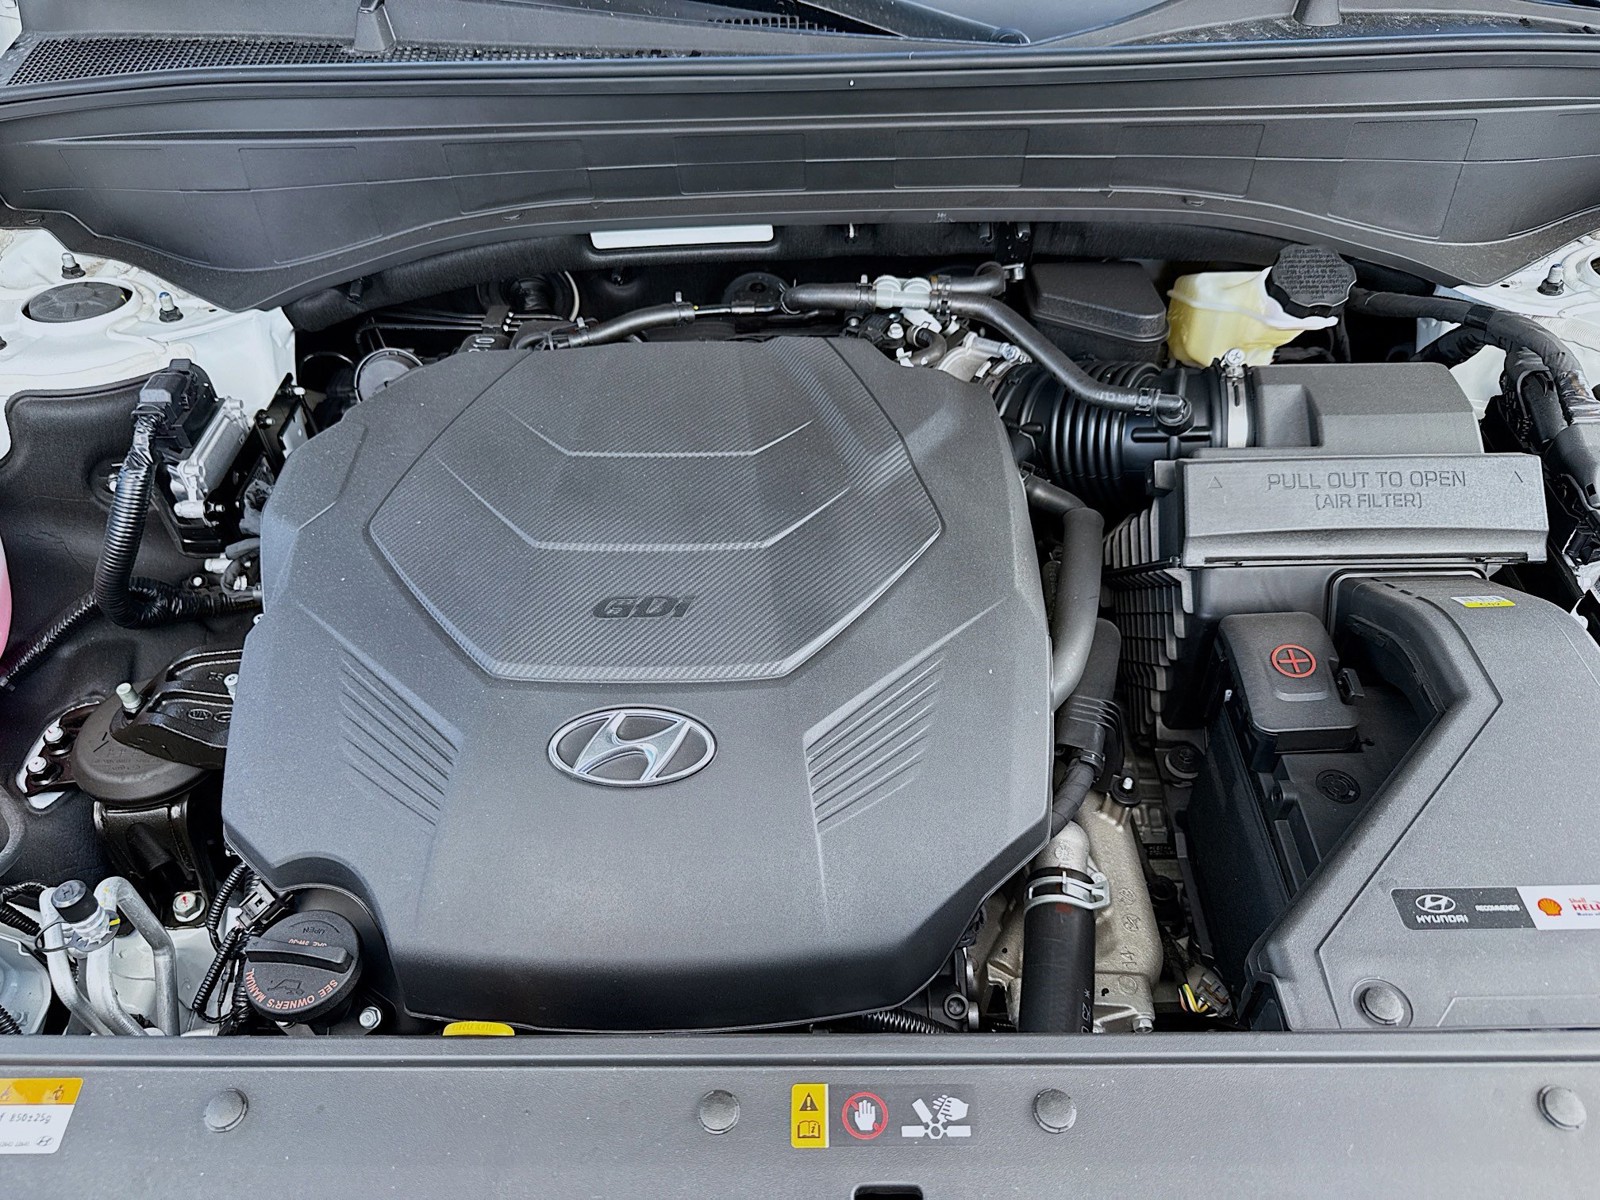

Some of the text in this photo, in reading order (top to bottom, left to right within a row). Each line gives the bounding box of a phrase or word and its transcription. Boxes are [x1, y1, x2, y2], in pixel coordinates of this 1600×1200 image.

[1266, 470, 1467, 490] PULL OUT TO OPEN
[1415, 914, 1469, 924] HYUNDAI
[246, 967, 339, 1010] SEE OWNER'S MANUAL
